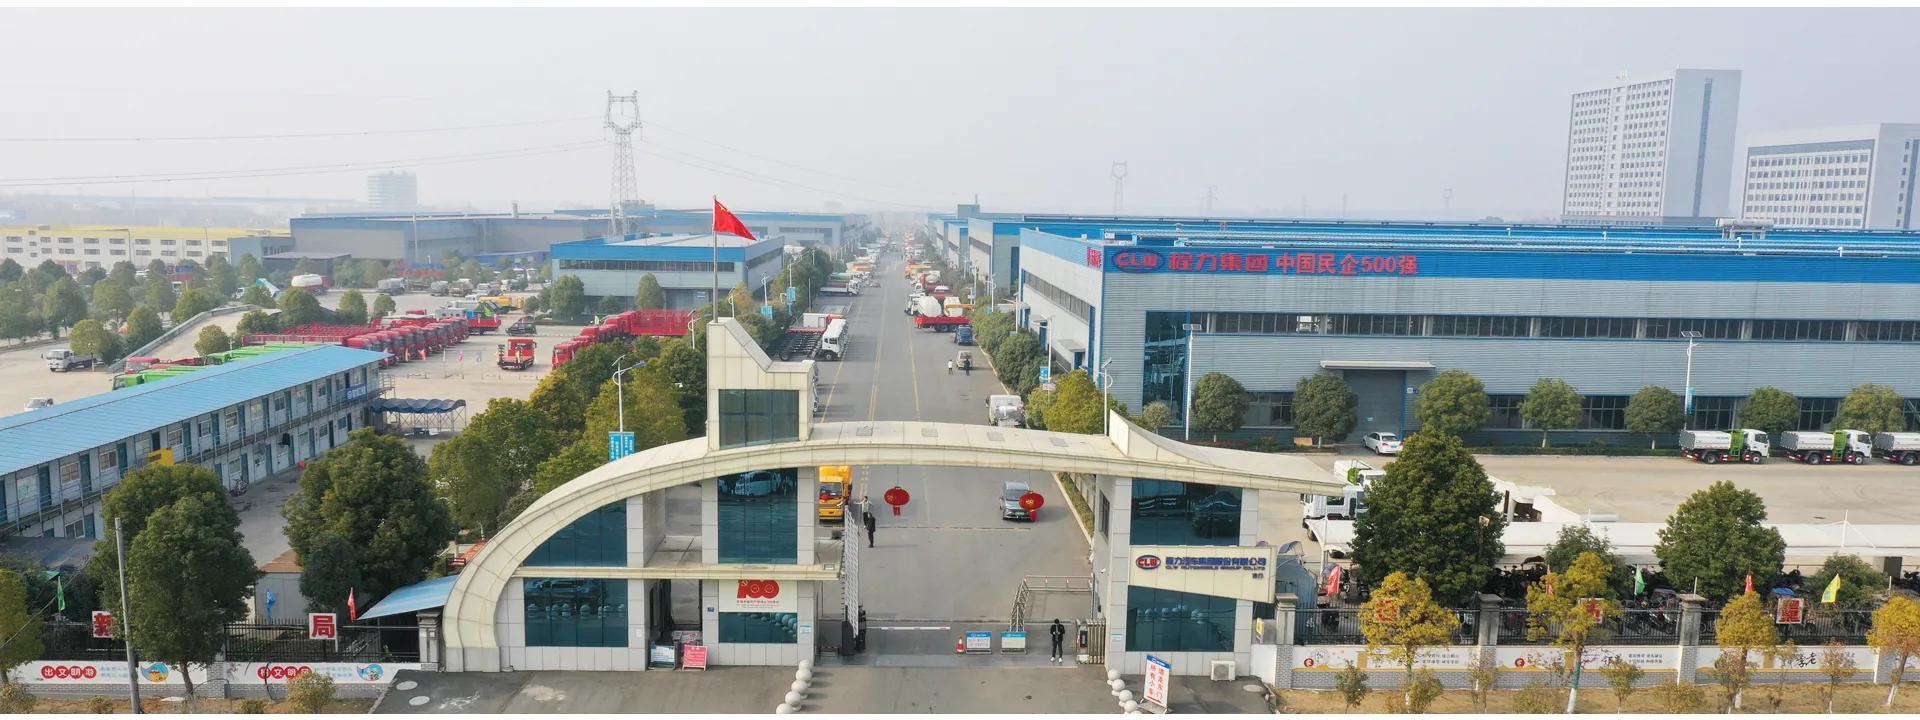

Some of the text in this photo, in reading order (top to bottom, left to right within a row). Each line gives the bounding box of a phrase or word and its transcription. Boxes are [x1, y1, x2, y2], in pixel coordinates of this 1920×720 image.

[1168, 253, 1268, 272] 程力集团
[1276, 252, 1418, 275] 中国民企500强
[1137, 558, 1158, 567] CLW
[311, 614, 336, 639] 局
